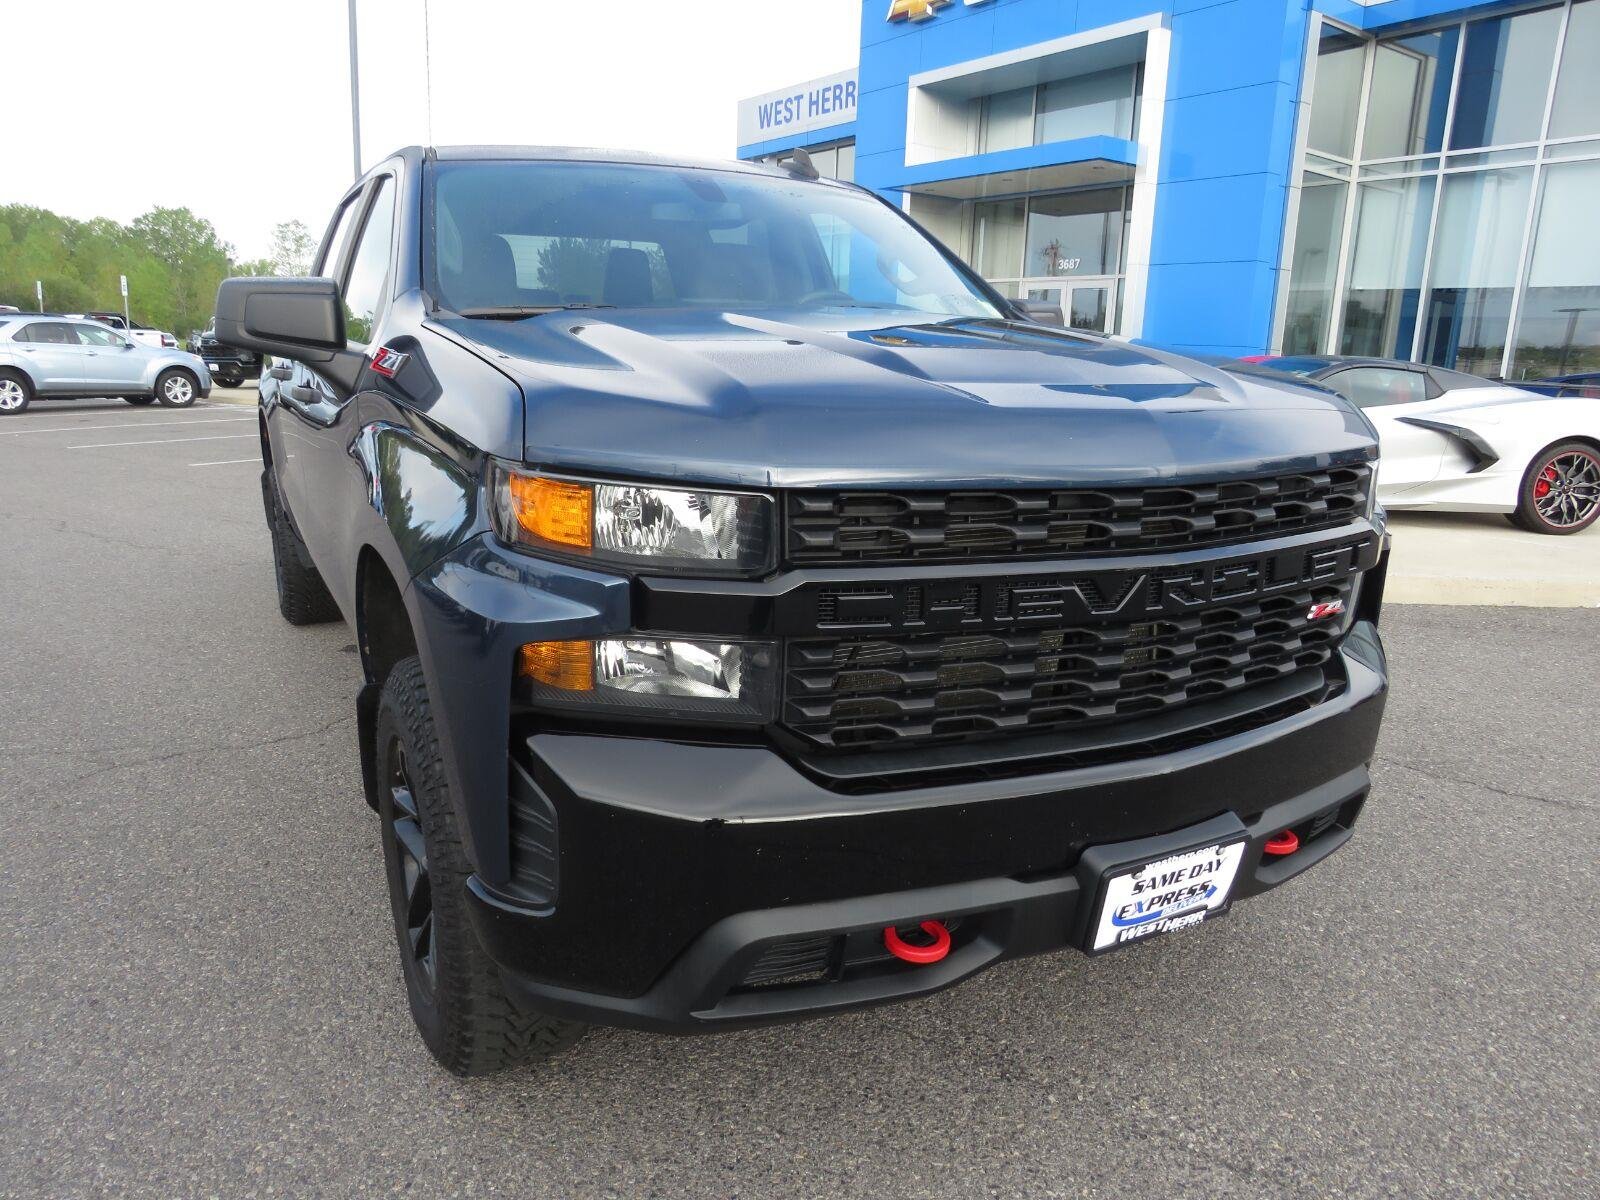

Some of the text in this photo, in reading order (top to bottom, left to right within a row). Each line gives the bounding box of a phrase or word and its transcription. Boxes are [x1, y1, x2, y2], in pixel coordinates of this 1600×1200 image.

[758, 80, 857, 129] WEST HERR
[1058, 258, 1080, 270] 3687
[816, 540, 1371, 629] CHEVROLET
[1131, 857, 1227, 896] SAME DAY
[1118, 879, 1212, 920] EXPRESS
